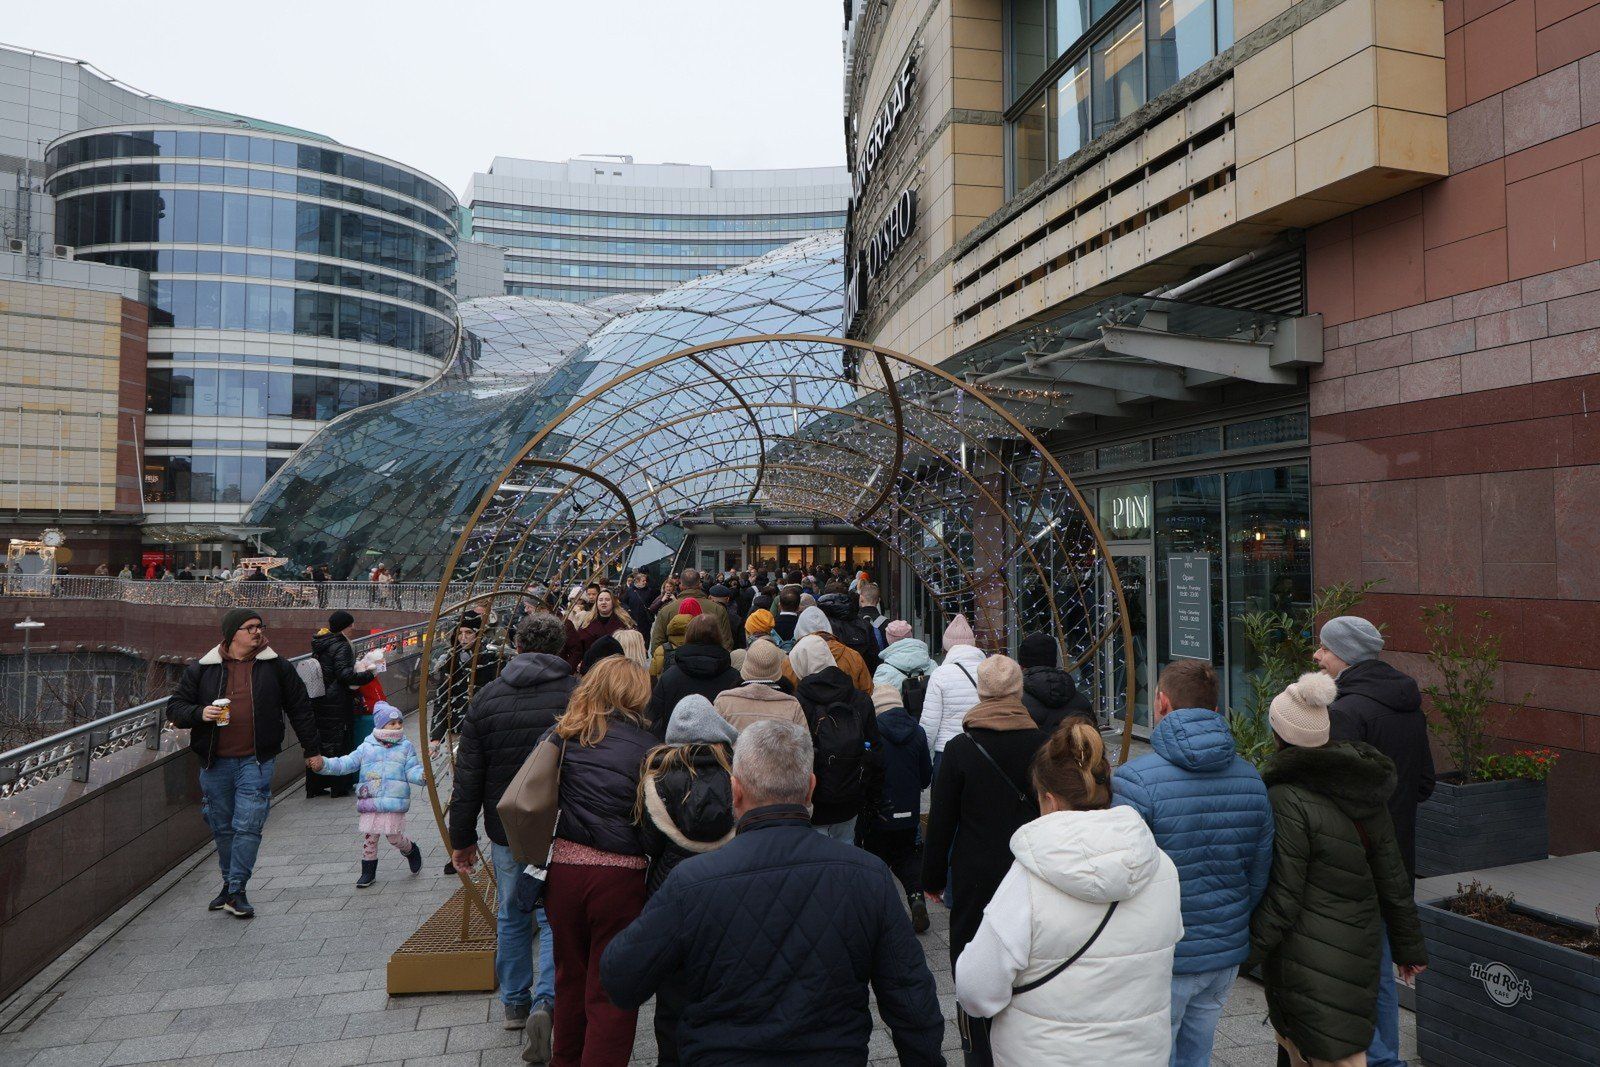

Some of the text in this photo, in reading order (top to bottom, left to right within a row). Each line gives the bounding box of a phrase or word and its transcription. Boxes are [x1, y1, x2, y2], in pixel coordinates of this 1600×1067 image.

[866, 57, 912, 171] GRAAF
[869, 189, 912, 279] OYSHO
[1112, 494, 1148, 530] PIN
[1471, 963, 1532, 1000] Hard Rock
[1494, 989, 1510, 999] CAFE
